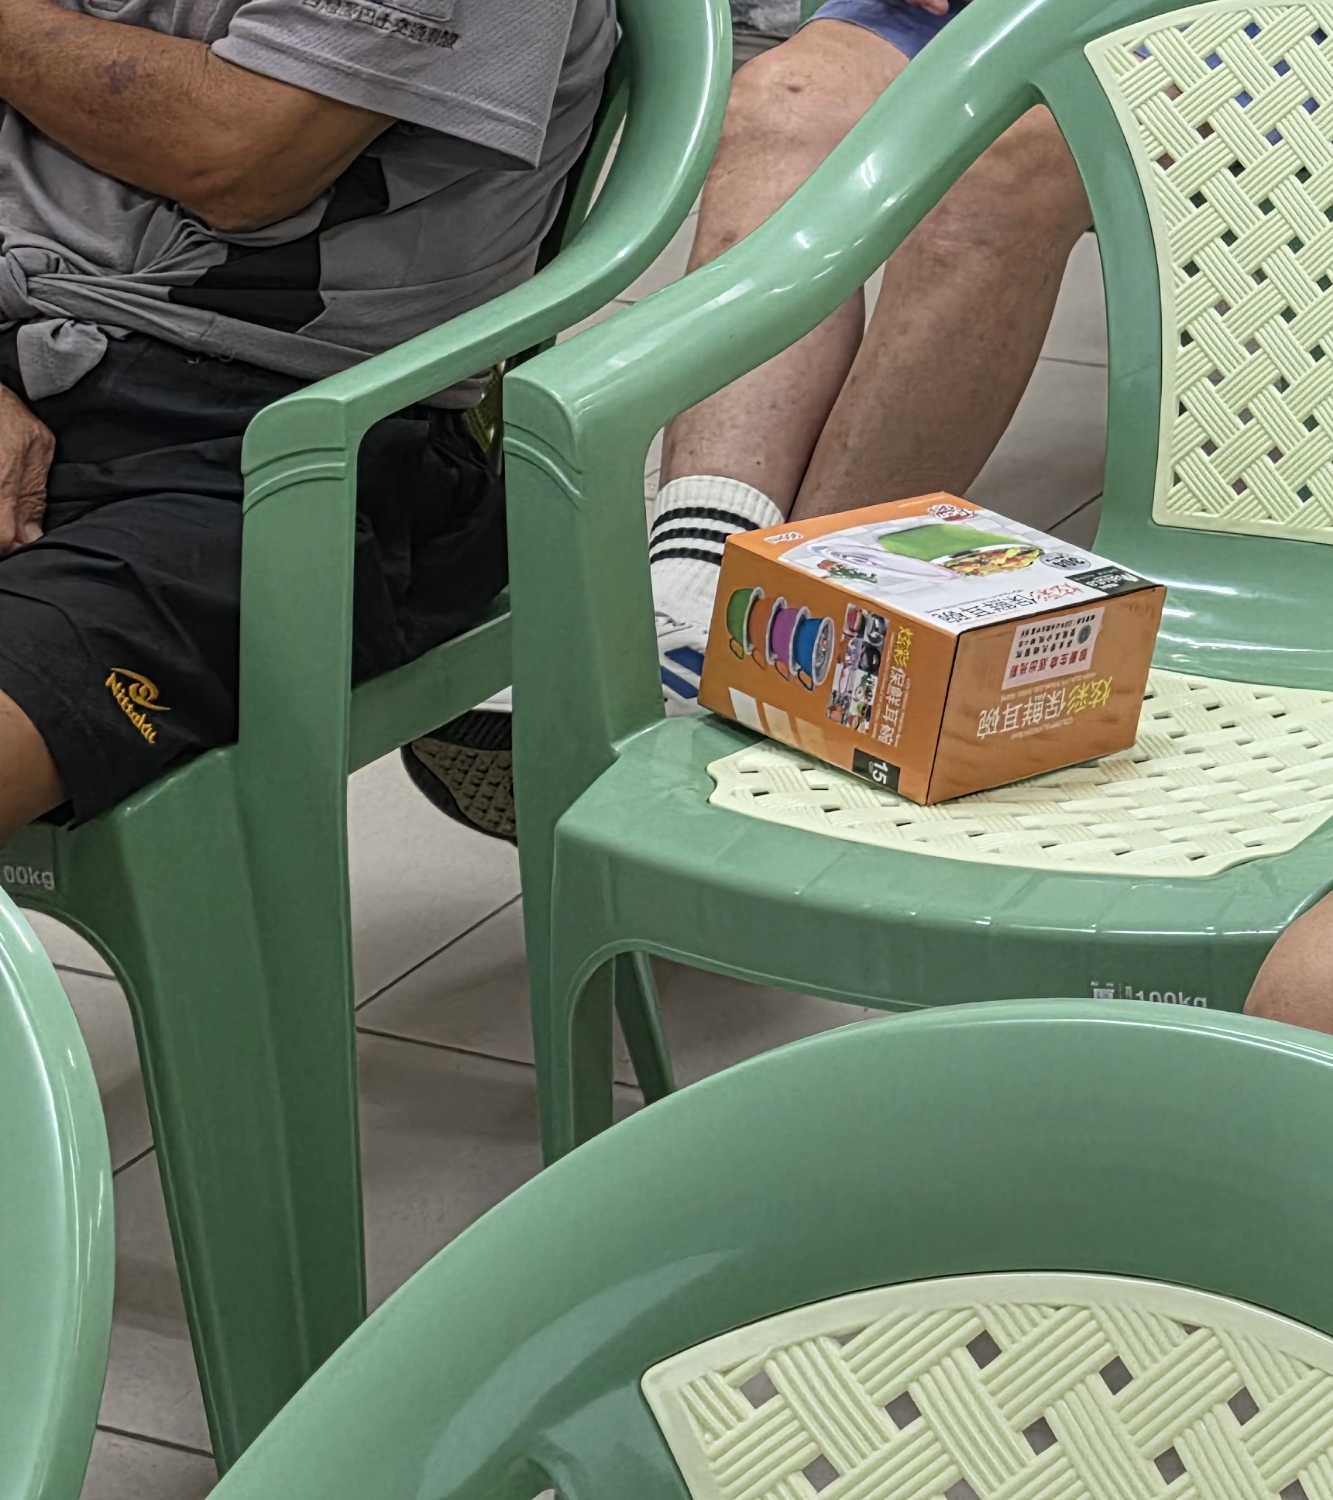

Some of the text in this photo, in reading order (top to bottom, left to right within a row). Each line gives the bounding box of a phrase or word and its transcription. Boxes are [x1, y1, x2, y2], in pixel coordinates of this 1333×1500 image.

[877, 625, 914, 746] 炫彩保鮮耳碗
[977, 676, 1113, 740] 炫彩保鮮耳碗
[871, 761, 889, 785] 15
